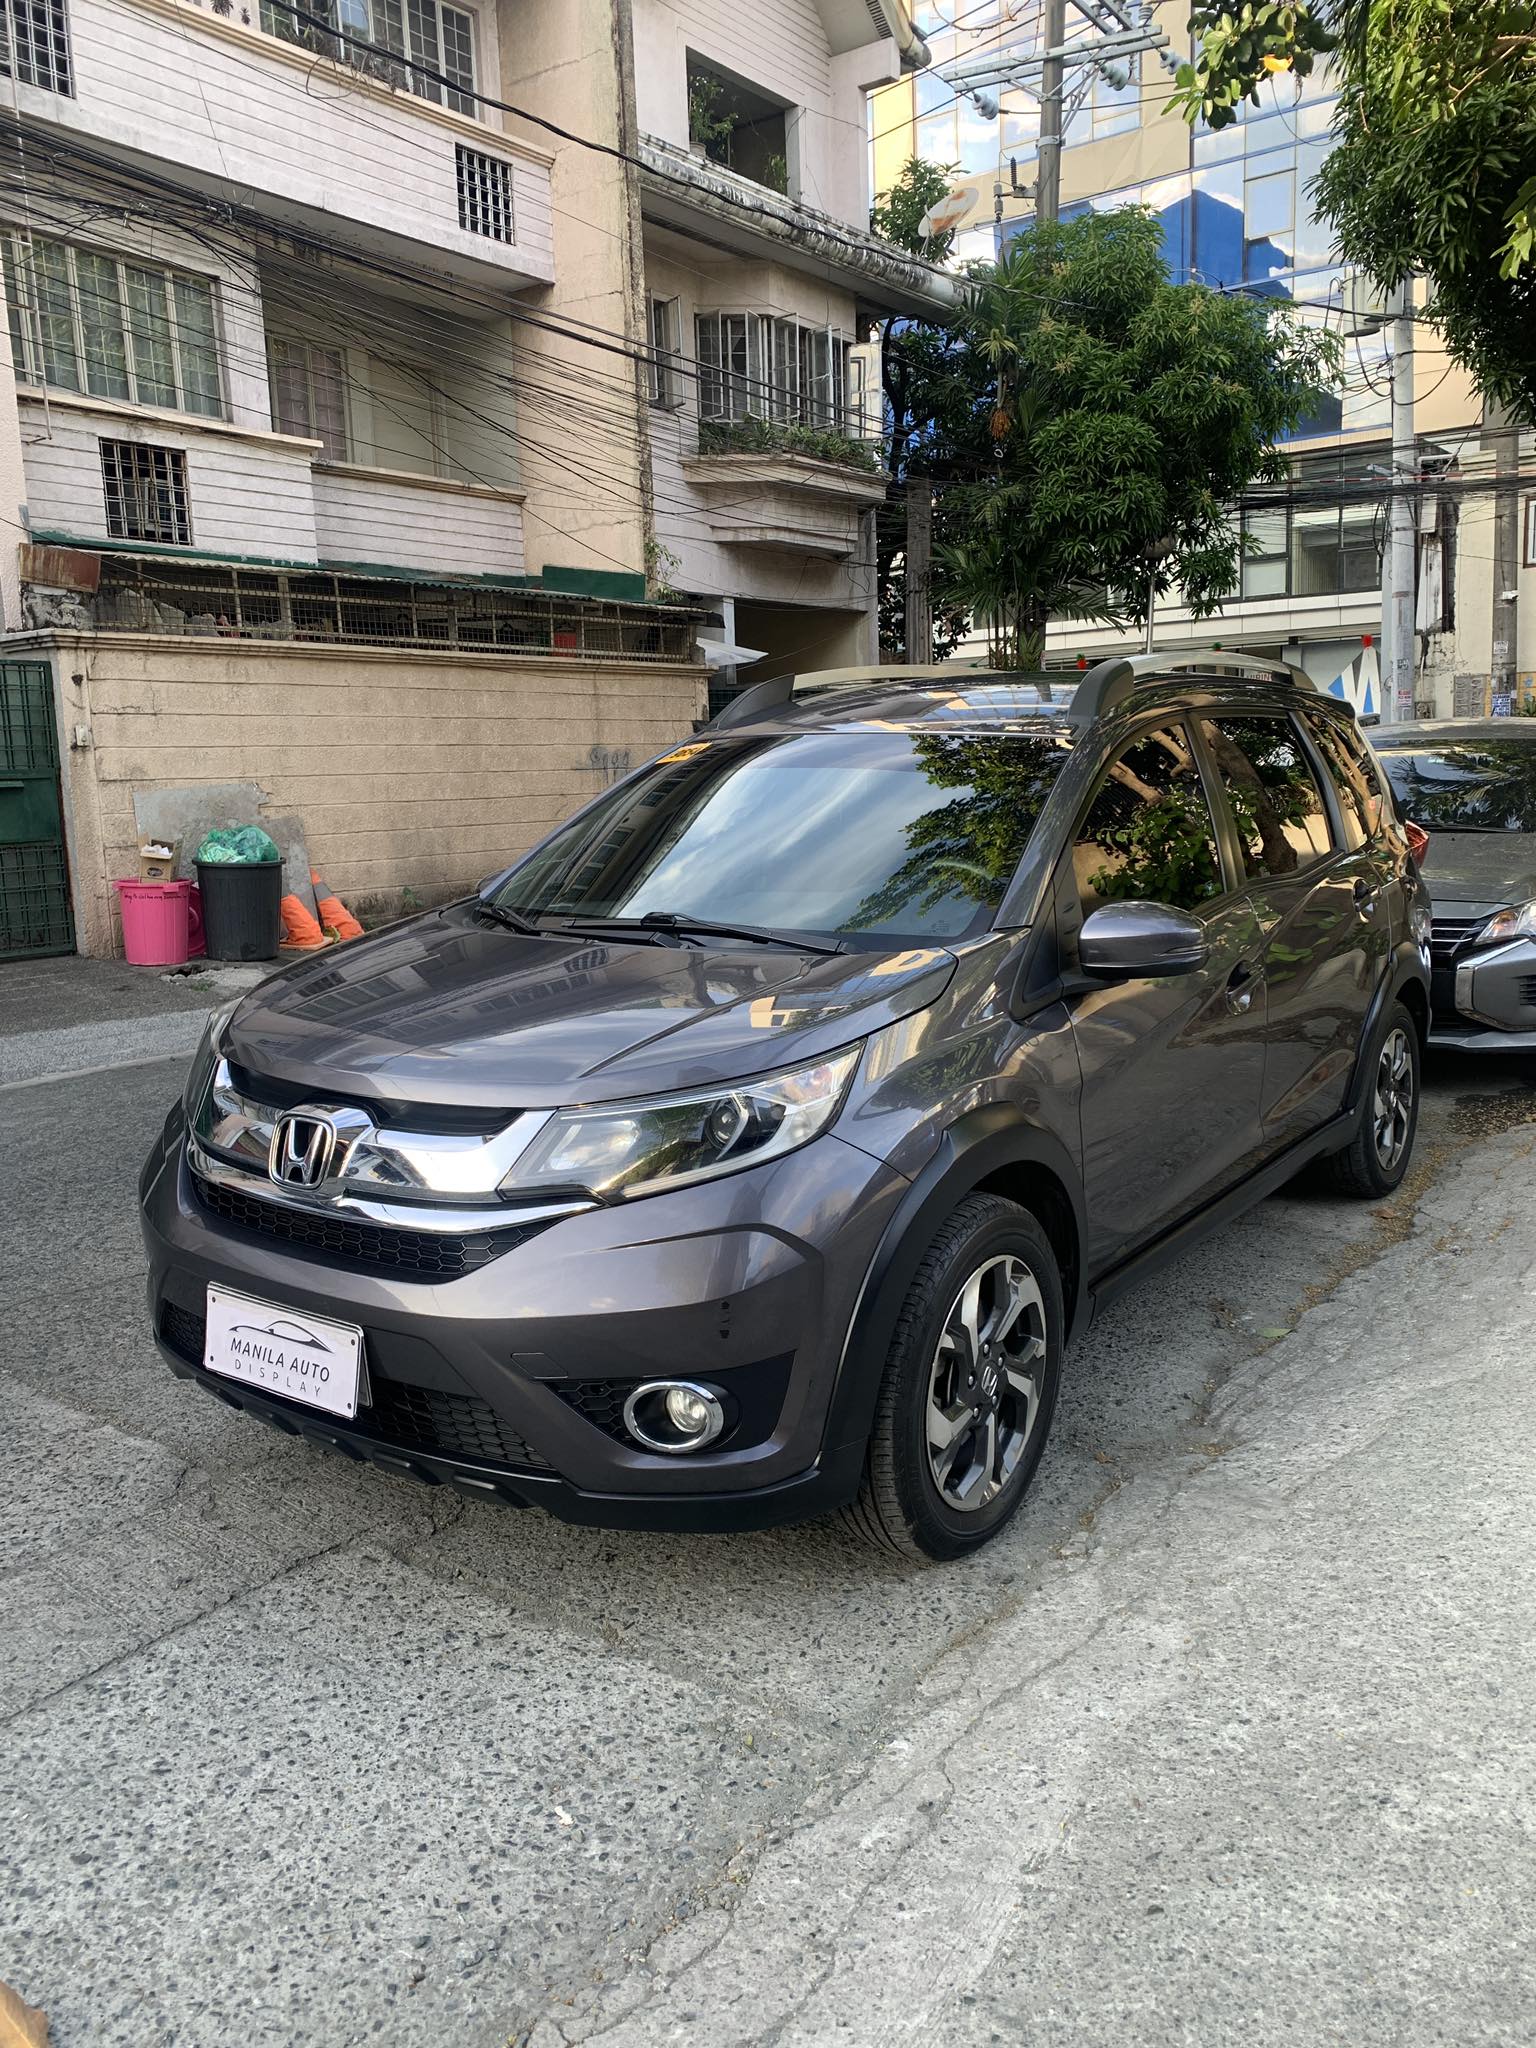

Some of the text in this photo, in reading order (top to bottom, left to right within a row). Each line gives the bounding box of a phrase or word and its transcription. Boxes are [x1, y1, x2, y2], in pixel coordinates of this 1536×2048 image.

[230, 1337, 330, 1382] MANILA AUTO
[234, 1359, 321, 1397] DISPLAY
